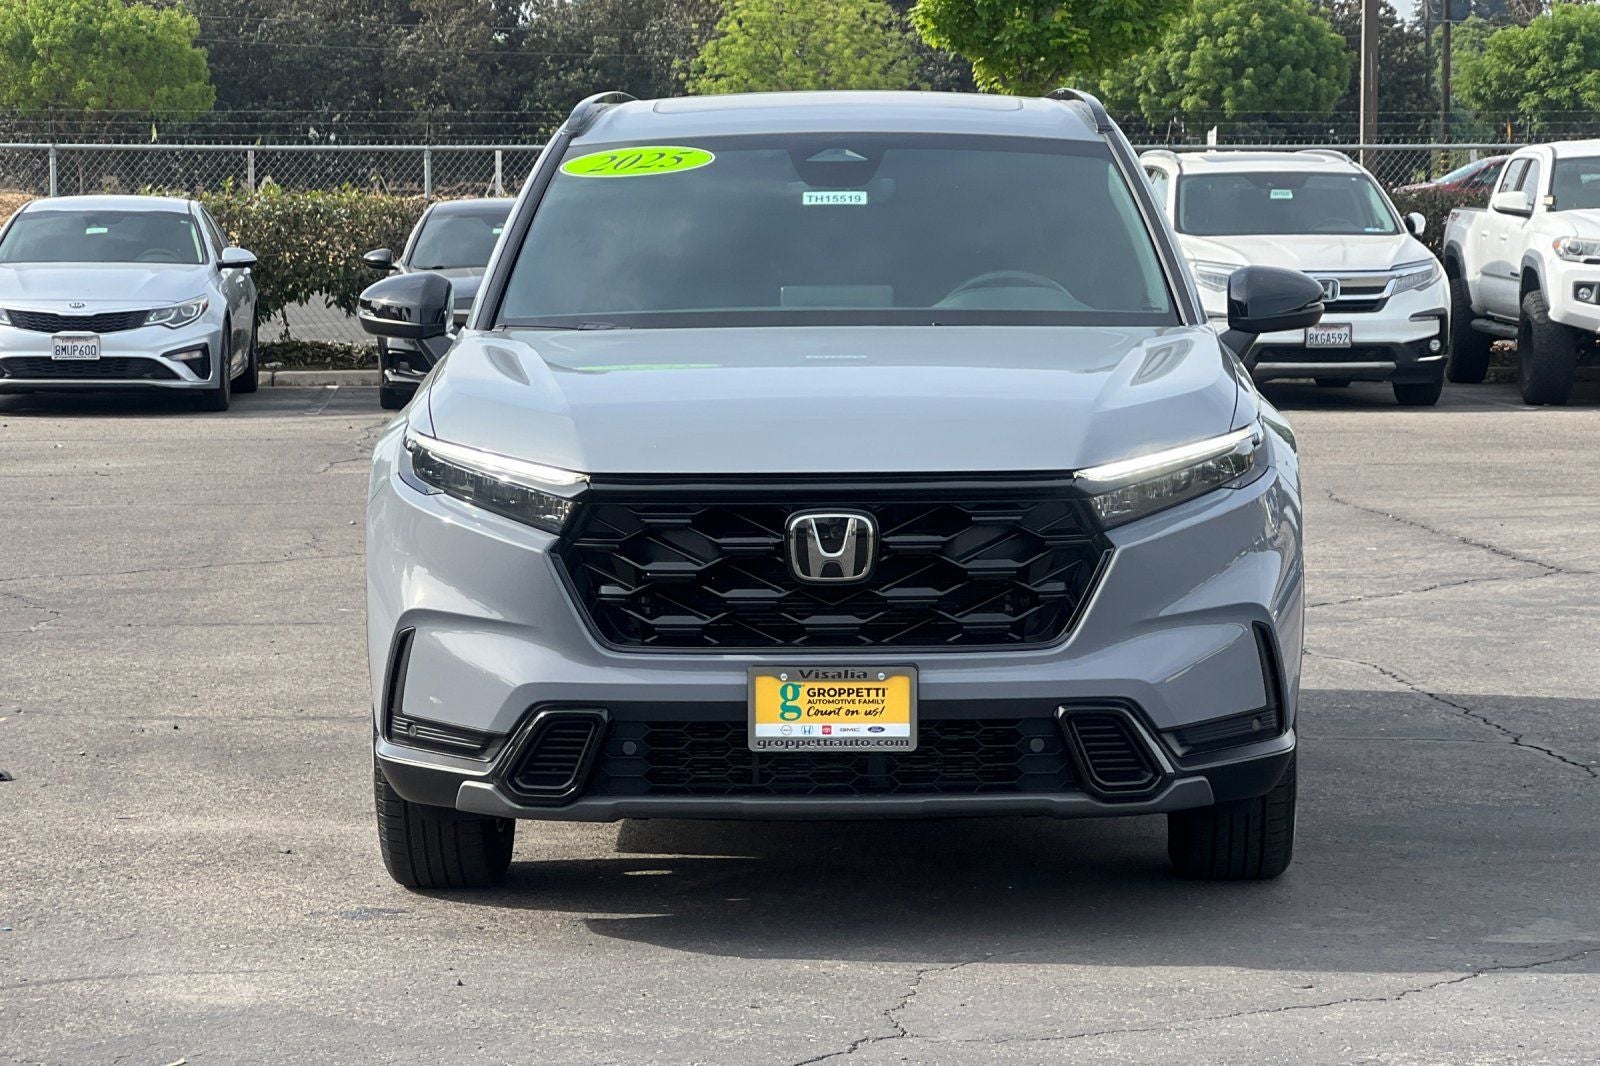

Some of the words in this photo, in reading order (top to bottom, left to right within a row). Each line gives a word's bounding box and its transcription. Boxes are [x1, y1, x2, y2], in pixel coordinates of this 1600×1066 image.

[585, 151, 694, 173] 2025
[806, 194, 862, 204] TH15519
[1308, 332, 1348, 345] 8KGA592
[55, 344, 97, 356] 8MUP600
[798, 669, 868, 680] Visalia
[806, 687, 886, 698] GROPPETTI
[806, 705, 843, 717] Count
[845, 708, 860, 717] on
[864, 705, 885, 717] us!
[757, 737, 909, 750] groppettiauto.com
